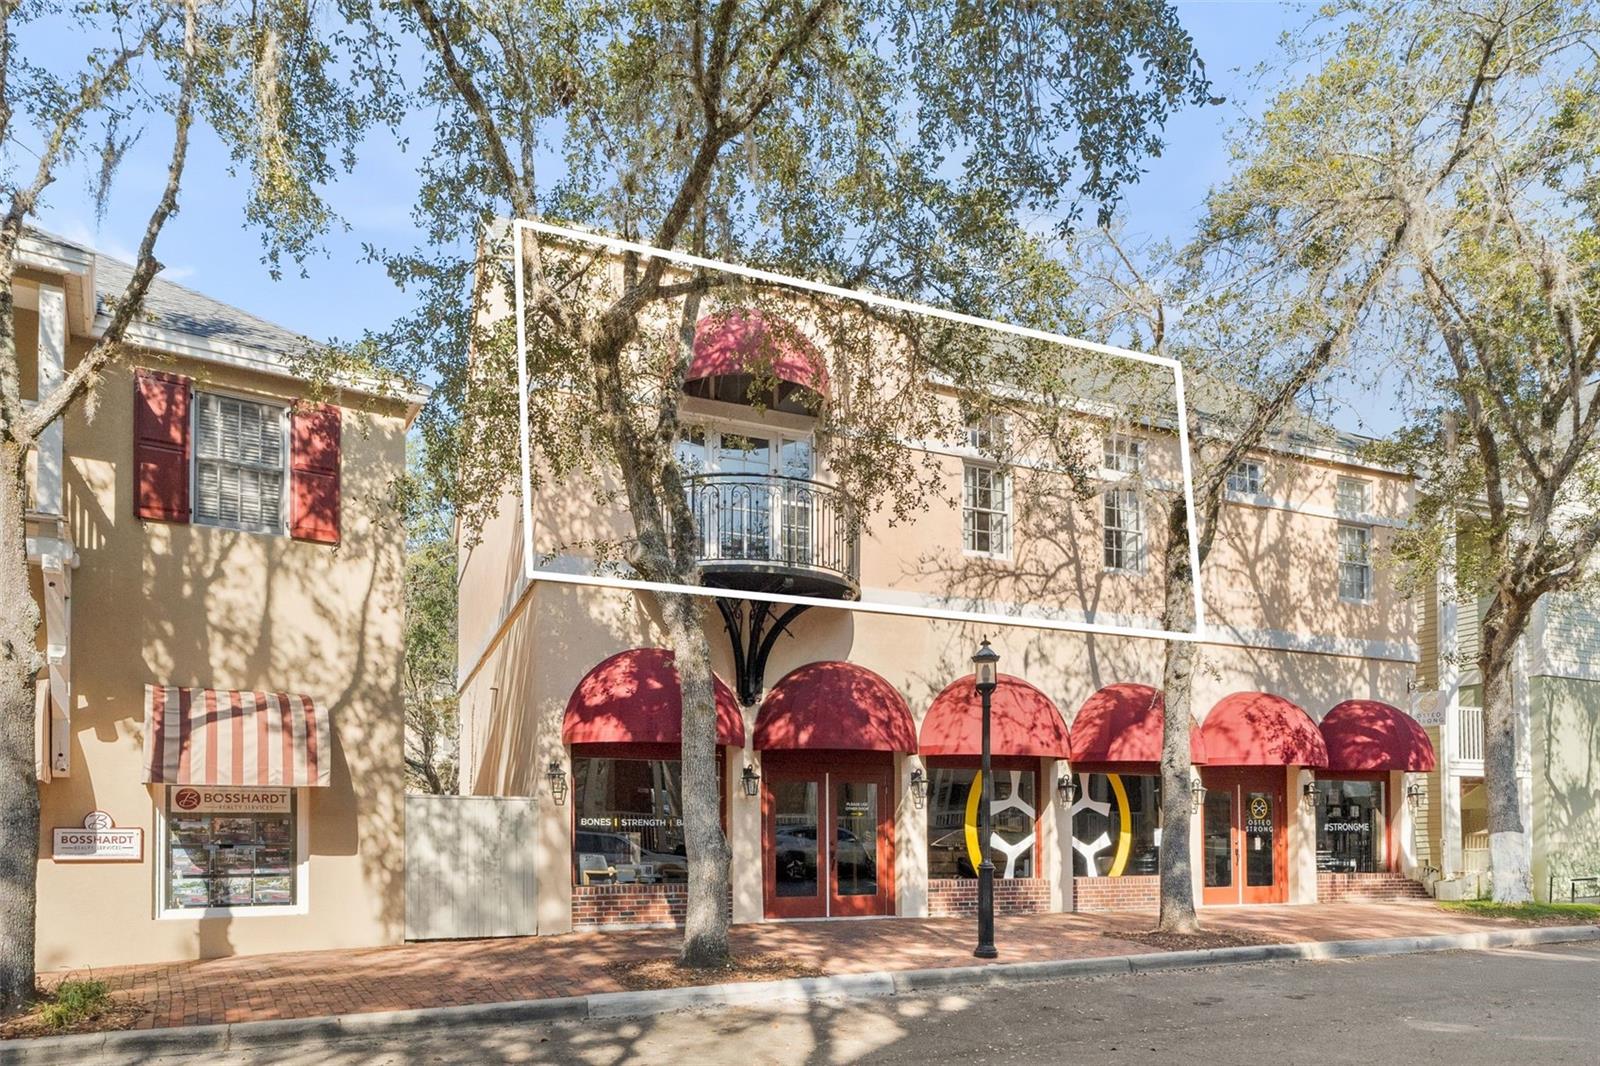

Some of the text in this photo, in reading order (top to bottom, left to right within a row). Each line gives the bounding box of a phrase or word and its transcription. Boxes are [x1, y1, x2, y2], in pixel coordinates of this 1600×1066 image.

[204, 792, 287, 803] BOSSHARDT
[580, 817, 611, 826] BONES
[621, 818, 666, 827] STRENGTH
[1324, 822, 1369, 831] #STRONGME
[61, 835, 134, 844] BOSSHARDT
